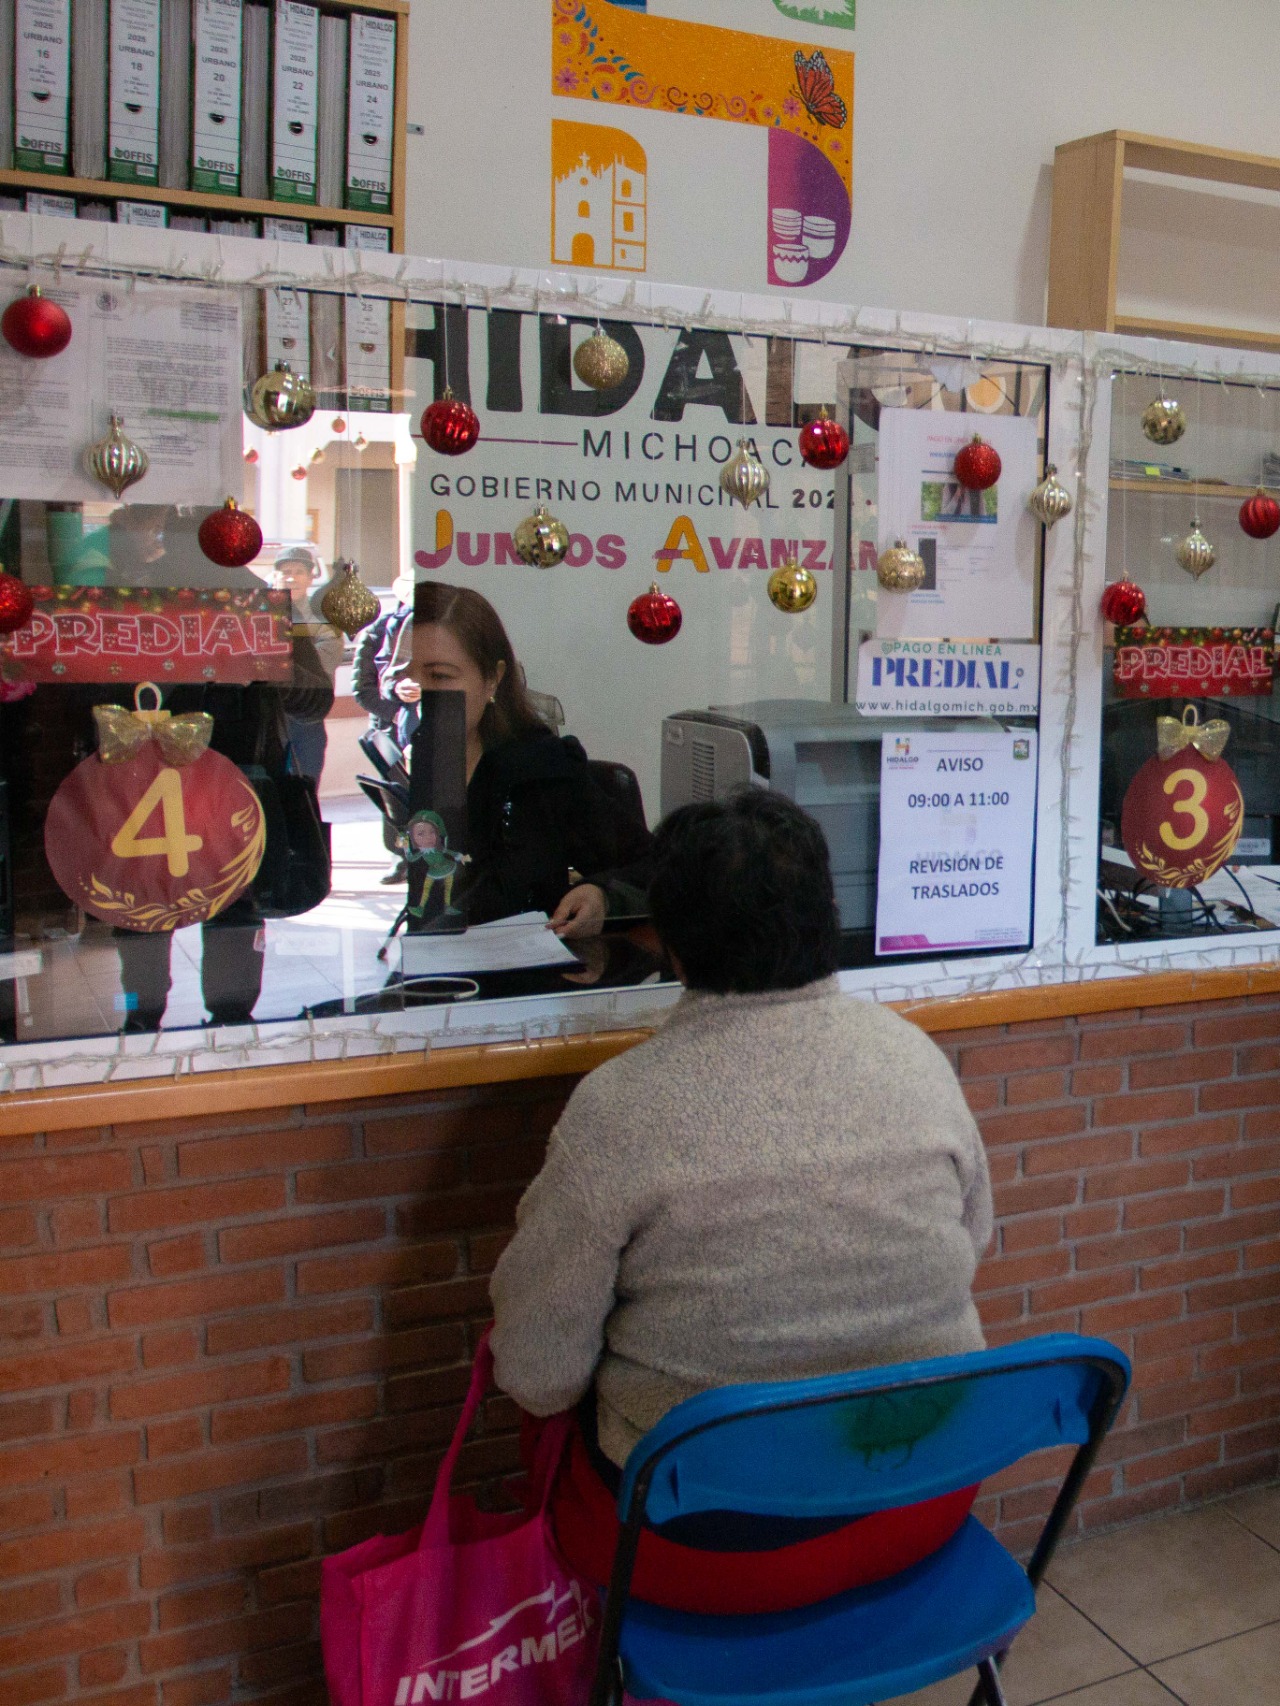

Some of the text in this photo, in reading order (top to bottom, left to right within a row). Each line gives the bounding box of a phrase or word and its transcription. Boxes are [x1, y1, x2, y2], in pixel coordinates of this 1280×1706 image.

[33, 20, 54, 30] 2025
[366, 20, 393, 33] HIDALGO
[23, 32, 62, 44] URBANO
[127, 33, 146, 43] 2025
[36, 49, 50, 59] 16
[118, 44, 155, 58] URBANO
[210, 45, 229, 54] 2025
[130, 61, 143, 71] 18
[201, 56, 237, 69] URBANO
[213, 73, 225, 82] 20
[281, 65, 314, 77] URBANO
[364, 69, 381, 78] 2025
[292, 82, 304, 91] 22
[355, 80, 389, 91] URBANO
[366, 95, 378, 104] 24
[123, 150, 153, 163] OFFIS
[206, 160, 235, 173] OFFIS
[285, 170, 311, 182] OFFIS
[359, 179, 386, 191] OFFIS
[132, 207, 160, 218] HIDALGO
[360, 230, 387, 241] HIDALGO
[362, 304, 373, 312] 25
[404, 303, 878, 432] HIDAL
[582, 428, 806, 467] MICHOAC
[430, 474, 835, 510] GOBIERNO MUNICIL 202
[414, 508, 628, 569] JUNOS
[13, 613, 290, 656] PREDIAL
[893, 641, 932, 654] PAGO
[937, 643, 956, 655] EN
[1119, 646, 1273, 679] PREDIAL
[871, 656, 1020, 690] PREDIAL
[856, 699, 1039, 714] www.hidalgomich.gob.mx
[886, 756, 919, 764] HIDALGO
[936, 757, 984, 772] AVISO
[907, 791, 1010, 808] 09:00 A 11:00
[1158, 768, 1210, 851] 3
[111, 767, 204, 877] 4
[984, 856, 1004, 870] DE
[911, 881, 1000, 900] TRASLADOS
